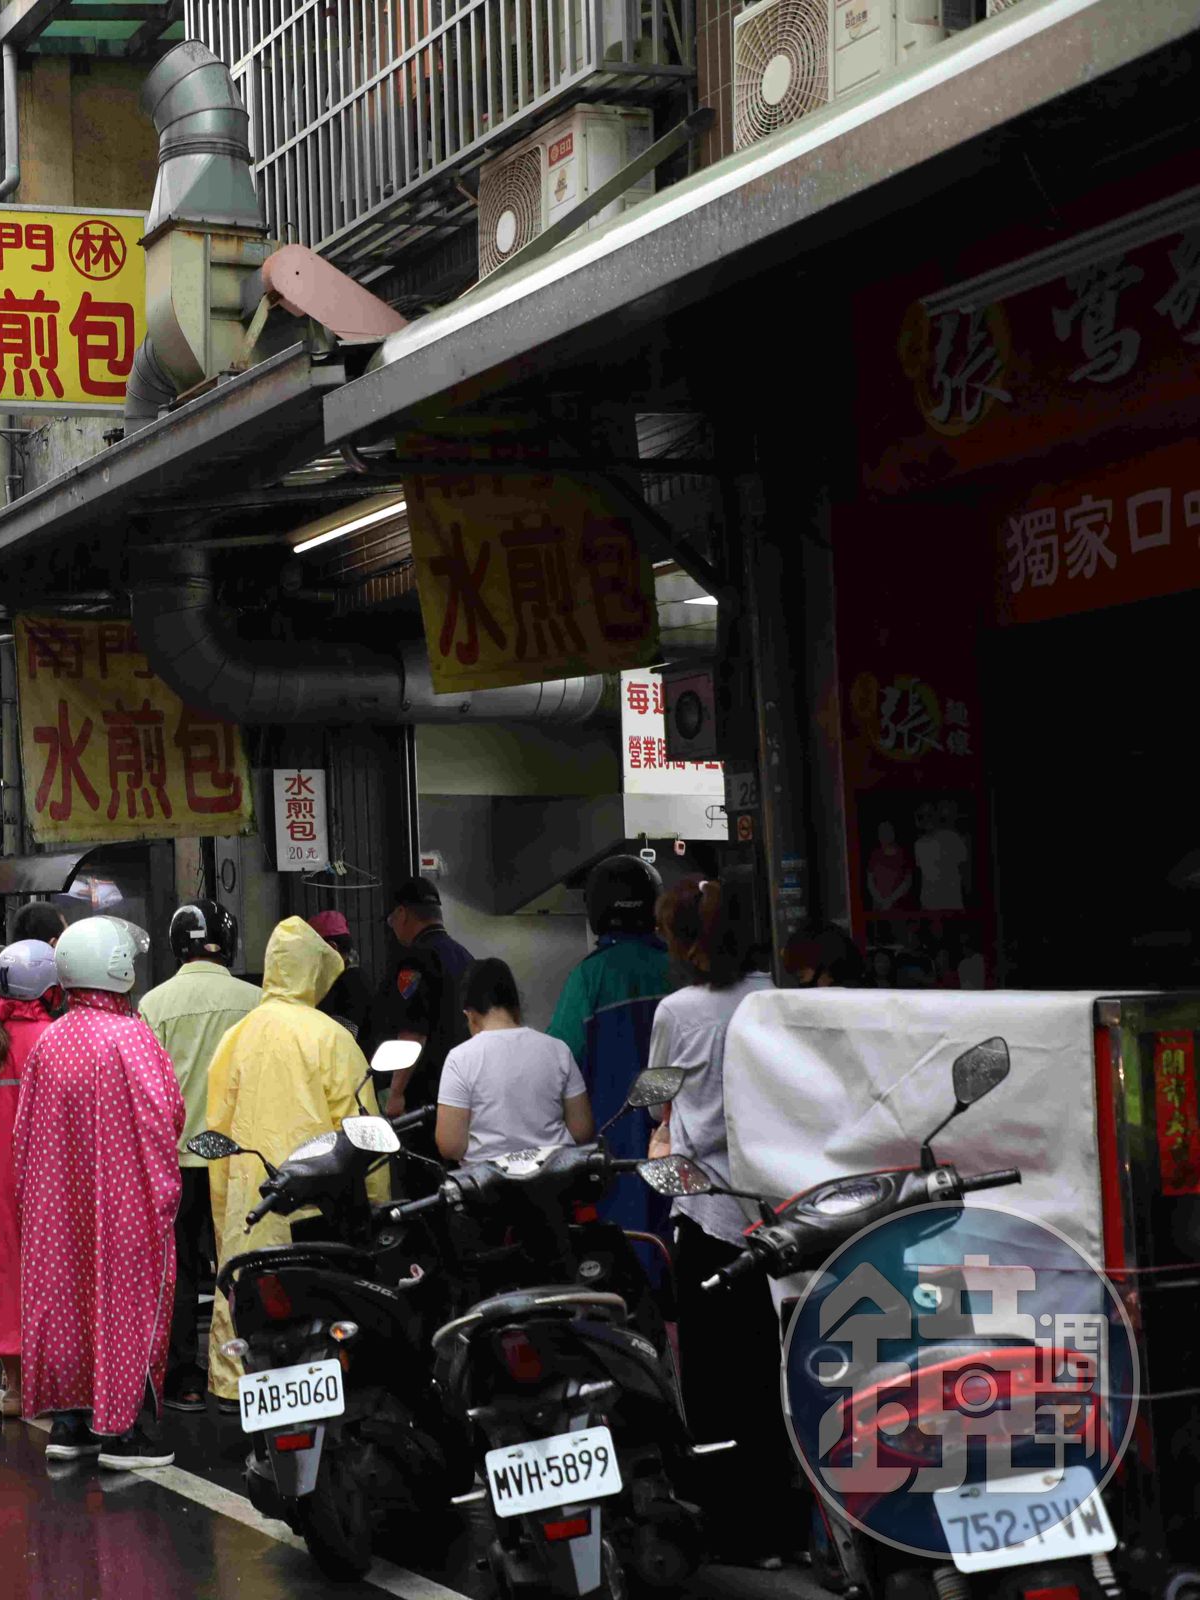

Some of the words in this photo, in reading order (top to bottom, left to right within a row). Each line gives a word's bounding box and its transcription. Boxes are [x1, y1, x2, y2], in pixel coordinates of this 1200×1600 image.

[430, 508, 650, 665] 水煎包
[32, 698, 242, 822] 水煎包
[284, 774, 316, 841] 水煎包
